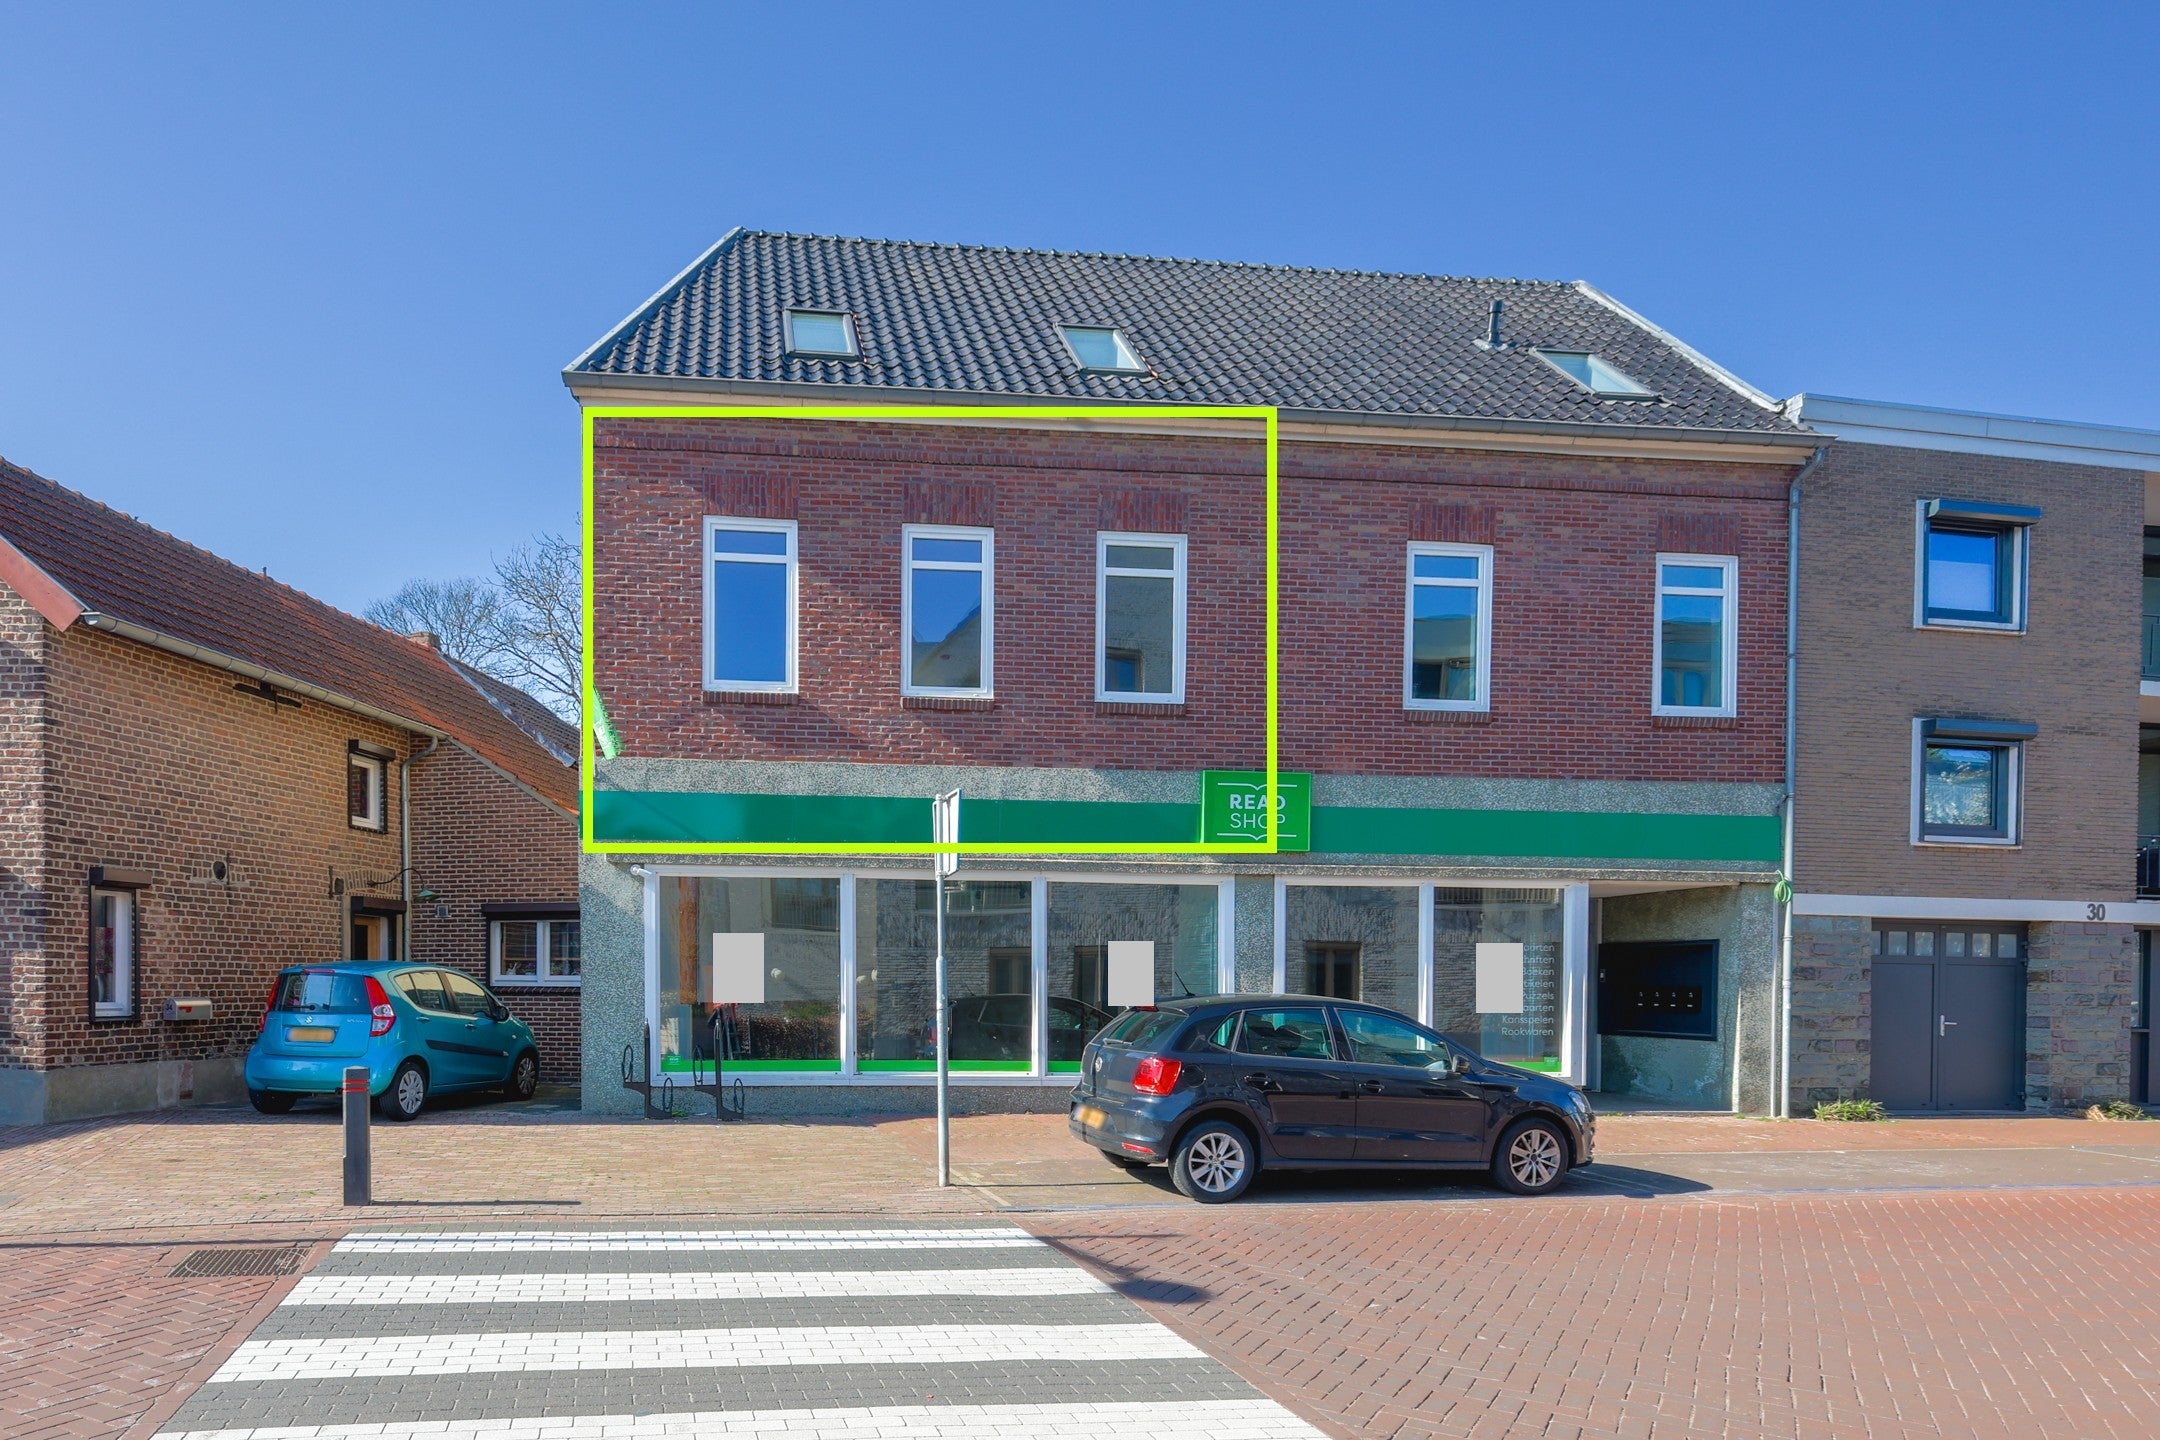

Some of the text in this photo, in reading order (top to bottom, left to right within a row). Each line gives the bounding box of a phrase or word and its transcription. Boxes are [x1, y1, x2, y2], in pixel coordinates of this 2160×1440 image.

[1229, 793, 1286, 810] READ
[2086, 903, 2106, 921] 30
[1502, 1014, 1554, 1026] Kansspelen
[1501, 1027, 1554, 1036] Rookwaren
